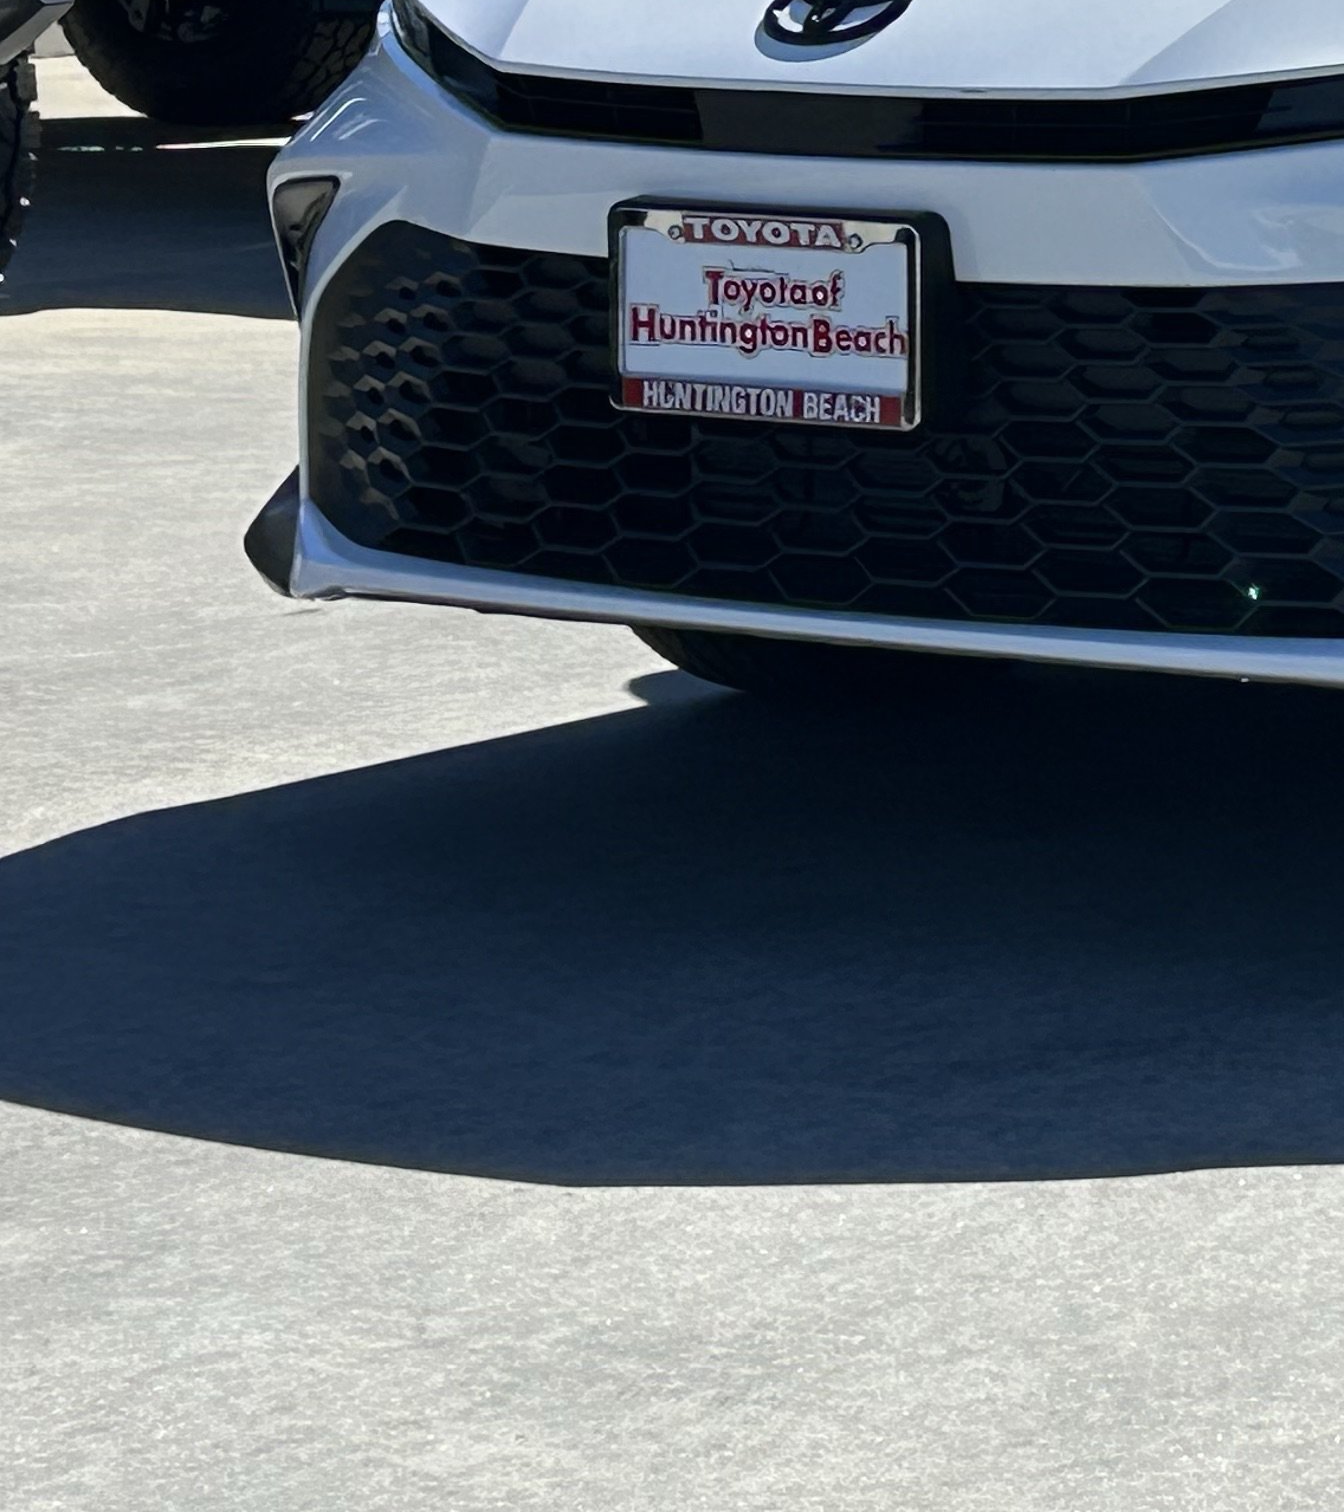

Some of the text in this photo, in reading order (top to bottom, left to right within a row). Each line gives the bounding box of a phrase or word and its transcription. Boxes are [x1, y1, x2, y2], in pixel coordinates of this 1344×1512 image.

[683, 217, 843, 248] TOYOTA
[642, 380, 881, 424] HUNTINGTON BEACH
